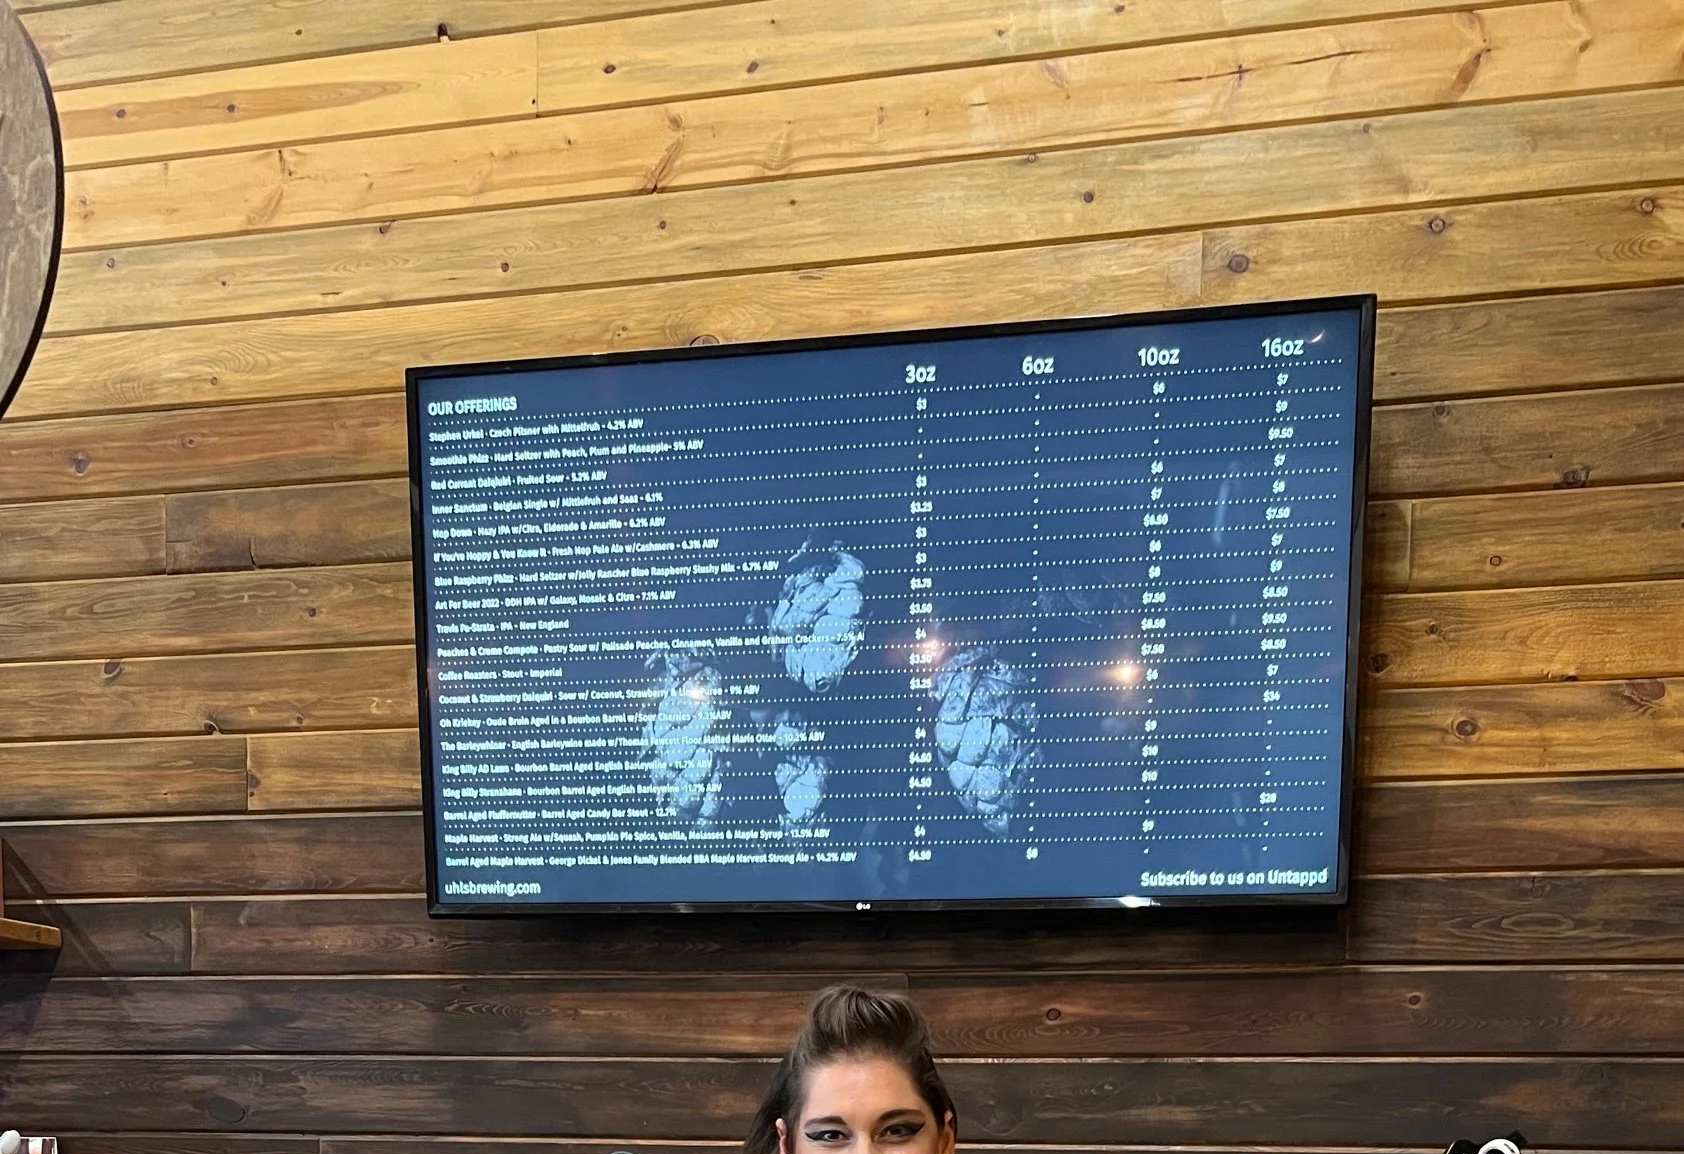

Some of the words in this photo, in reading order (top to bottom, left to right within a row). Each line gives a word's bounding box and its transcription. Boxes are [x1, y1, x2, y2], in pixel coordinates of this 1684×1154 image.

[1261, 337, 1304, 358] 16oz
[1022, 355, 1054, 375] 6oz
[1137, 346, 1180, 367] 10oz
[905, 363, 936, 384] 3oz
[1277, 372, 1289, 386] $7
[428, 401, 453, 416] OUR
[455, 396, 517, 414] OFFERINGS
[428, 430, 461, 443] Stephen
[513, 425, 540, 436] Pilsner
[542, 424, 559, 434] with
[1268, 427, 1293, 440] $9.50
[494, 451, 513, 462] Hard
[543, 448, 560, 459] with
[589, 445, 609, 456] Plum
[611, 444, 627, 455] and
[1274, 453, 1286, 467] $7
[431, 480, 446, 491] Red
[545, 473, 564, 484] Sour
[431, 504, 453, 515] Inner
[525, 498, 549, 512] Single
[602, 494, 618, 505] and
[432, 528, 449, 541] Hop
[478, 526, 496, 539] Hazy
[497, 525, 511, 535] IPA
[580, 521, 587, 531] &
[588, 519, 622, 531] Amarillo
[493, 550, 499, 559] &
[500, 549, 516, 559] You
[574, 545, 591, 557] Hop
[592, 544, 609, 554] Pale
[610, 543, 623, 553] Ale
[434, 576, 452, 587] Blue
[519, 572, 538, 583] Hard
[597, 567, 630, 579] Rancher
[631, 566, 649, 577] Blue
[650, 564, 691, 578] Raspberry
[607, 593, 614, 602] &
[1142, 591, 1166, 604] $7.50
[537, 618, 569, 632] England
[1262, 612, 1287, 625] $9.50
[469, 647, 476, 657] &
[568, 643, 587, 654] Sour
[601, 641, 634, 652] Palisade
[744, 636, 759, 647] and
[761, 635, 792, 646] Graham
[530, 668, 562, 680] Imperial
[1266, 664, 1278, 676] $7
[472, 694, 478, 704] &
[558, 691, 577, 701] Sour
[743, 685, 760, 695] ABV
[530, 716, 550, 728] Aged
[551, 716, 559, 725] in
[567, 714, 601, 724] Bourbon
[602, 714, 626, 723] Barrel
[441, 742, 455, 752] The
[511, 740, 539, 752] English
[514, 763, 547, 773] Bourbon
[549, 762, 572, 772] Barrel
[573, 762, 593, 774] Aged
[594, 761, 623, 773] English
[527, 786, 560, 796] Bourbon
[562, 785, 585, 795] Barrel
[586, 785, 605, 797] Aged
[607, 784, 635, 797] English
[468, 811, 487, 823] Aged
[541, 809, 565, 819] Barrel
[566, 809, 585, 821] Aged
[586, 808, 610, 820] Candy
[612, 808, 625, 818] Bar
[503, 833, 528, 845] Strong
[530, 833, 542, 843] Ale
[726, 830, 733, 840] &
[760, 829, 782, 842] Syrup
[814, 828, 829, 839] ABV
[469, 857, 488, 869] Aged
[549, 856, 576, 868] George
[602, 855, 609, 865] &
[610, 855, 632, 865] Jones
[633, 855, 659, 867] Family
[768, 853, 794, 865] Strong
[796, 852, 809, 862] Ale
[1141, 869, 1207, 887] Subscribe
[1210, 871, 1225, 886] to
[1228, 872, 1244, 885] us
[1247, 871, 1264, 885] on
[1267, 867, 1328, 887] Untappd
[444, 879, 541, 897] uhlsbrewing.com
